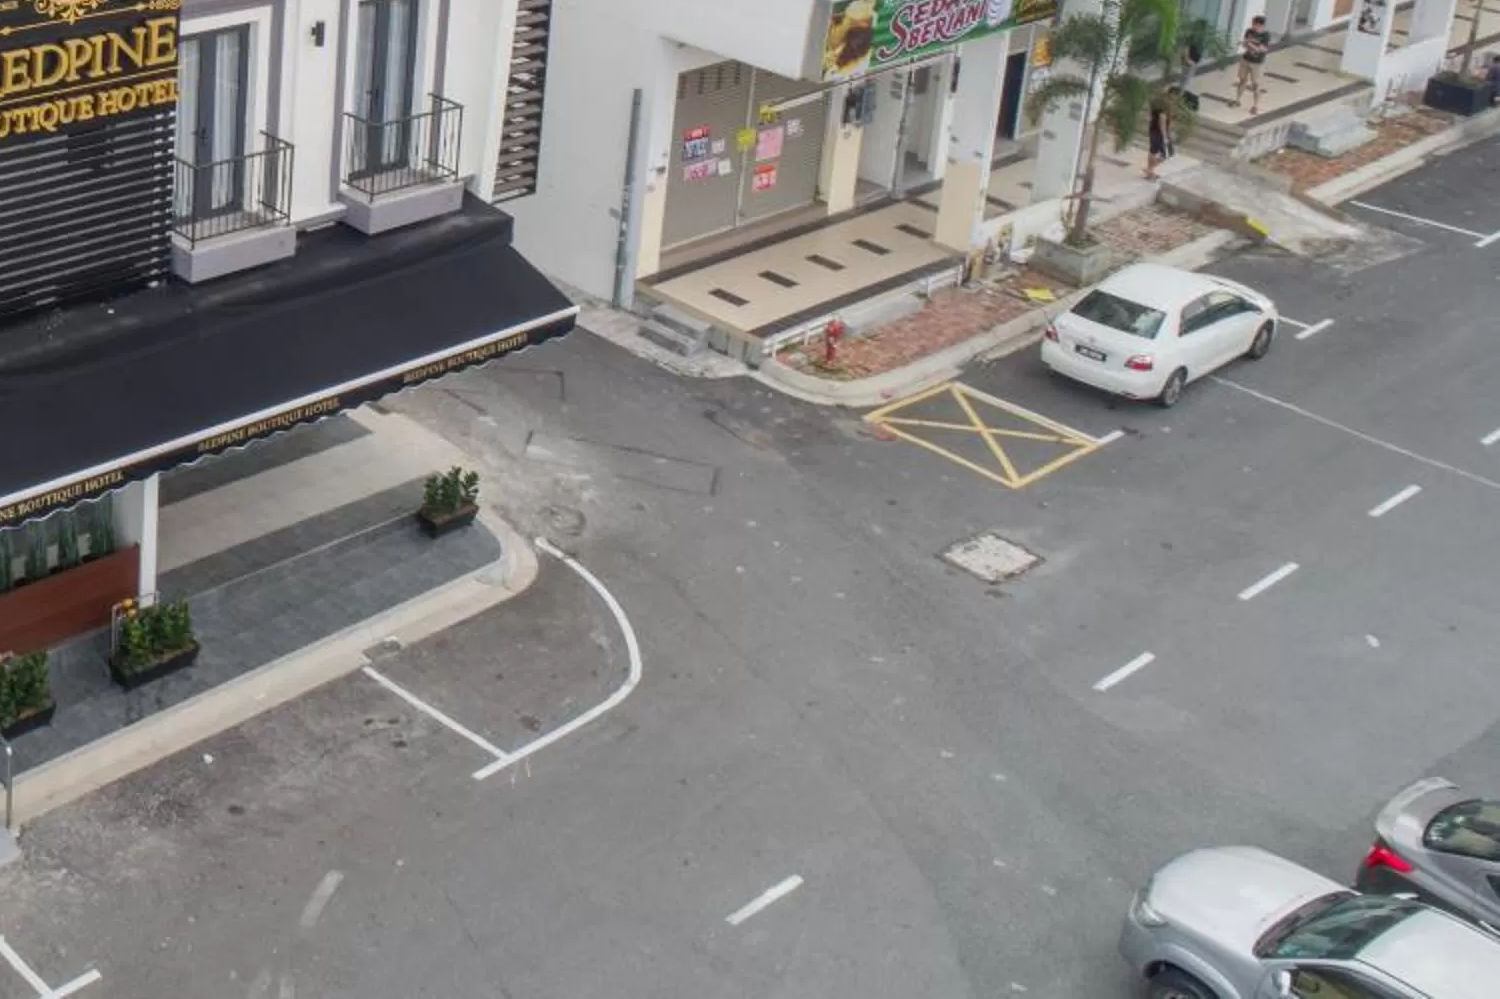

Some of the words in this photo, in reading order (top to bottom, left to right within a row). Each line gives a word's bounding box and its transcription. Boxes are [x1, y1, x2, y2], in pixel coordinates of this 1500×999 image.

[98, 78, 179, 117] HOTEL
[197, 428, 247, 452] REDPINE
[247, 408, 304, 438] BOUTIQUE
[304, 397, 340, 417] HOTEL
[18, 484, 83, 516] BOUTIQUE
[85, 470, 124, 492] HOTEL
